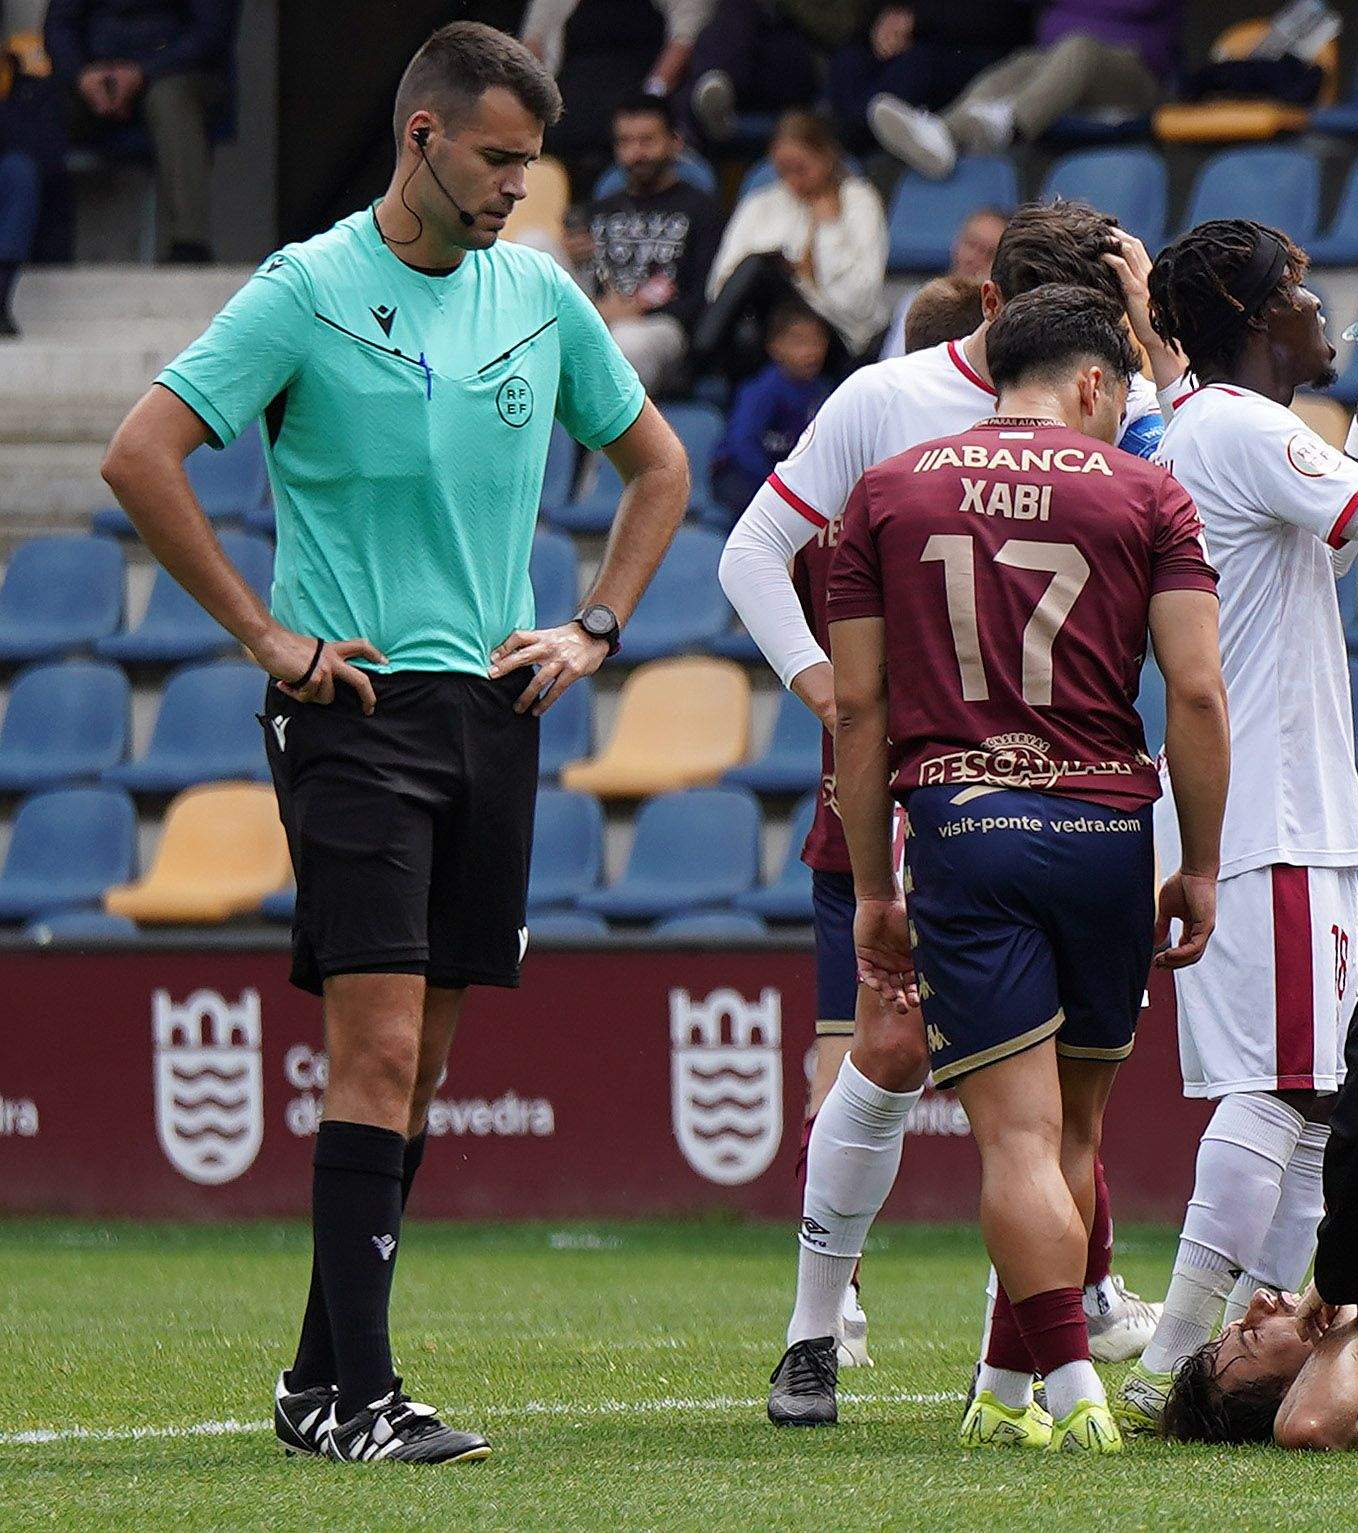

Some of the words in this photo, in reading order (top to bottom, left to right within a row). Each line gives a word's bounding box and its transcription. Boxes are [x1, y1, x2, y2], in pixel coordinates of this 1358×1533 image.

[913, 445, 1114, 476] ABANCA
[959, 478, 1052, 522] XABI
[920, 533, 1091, 706] 17
